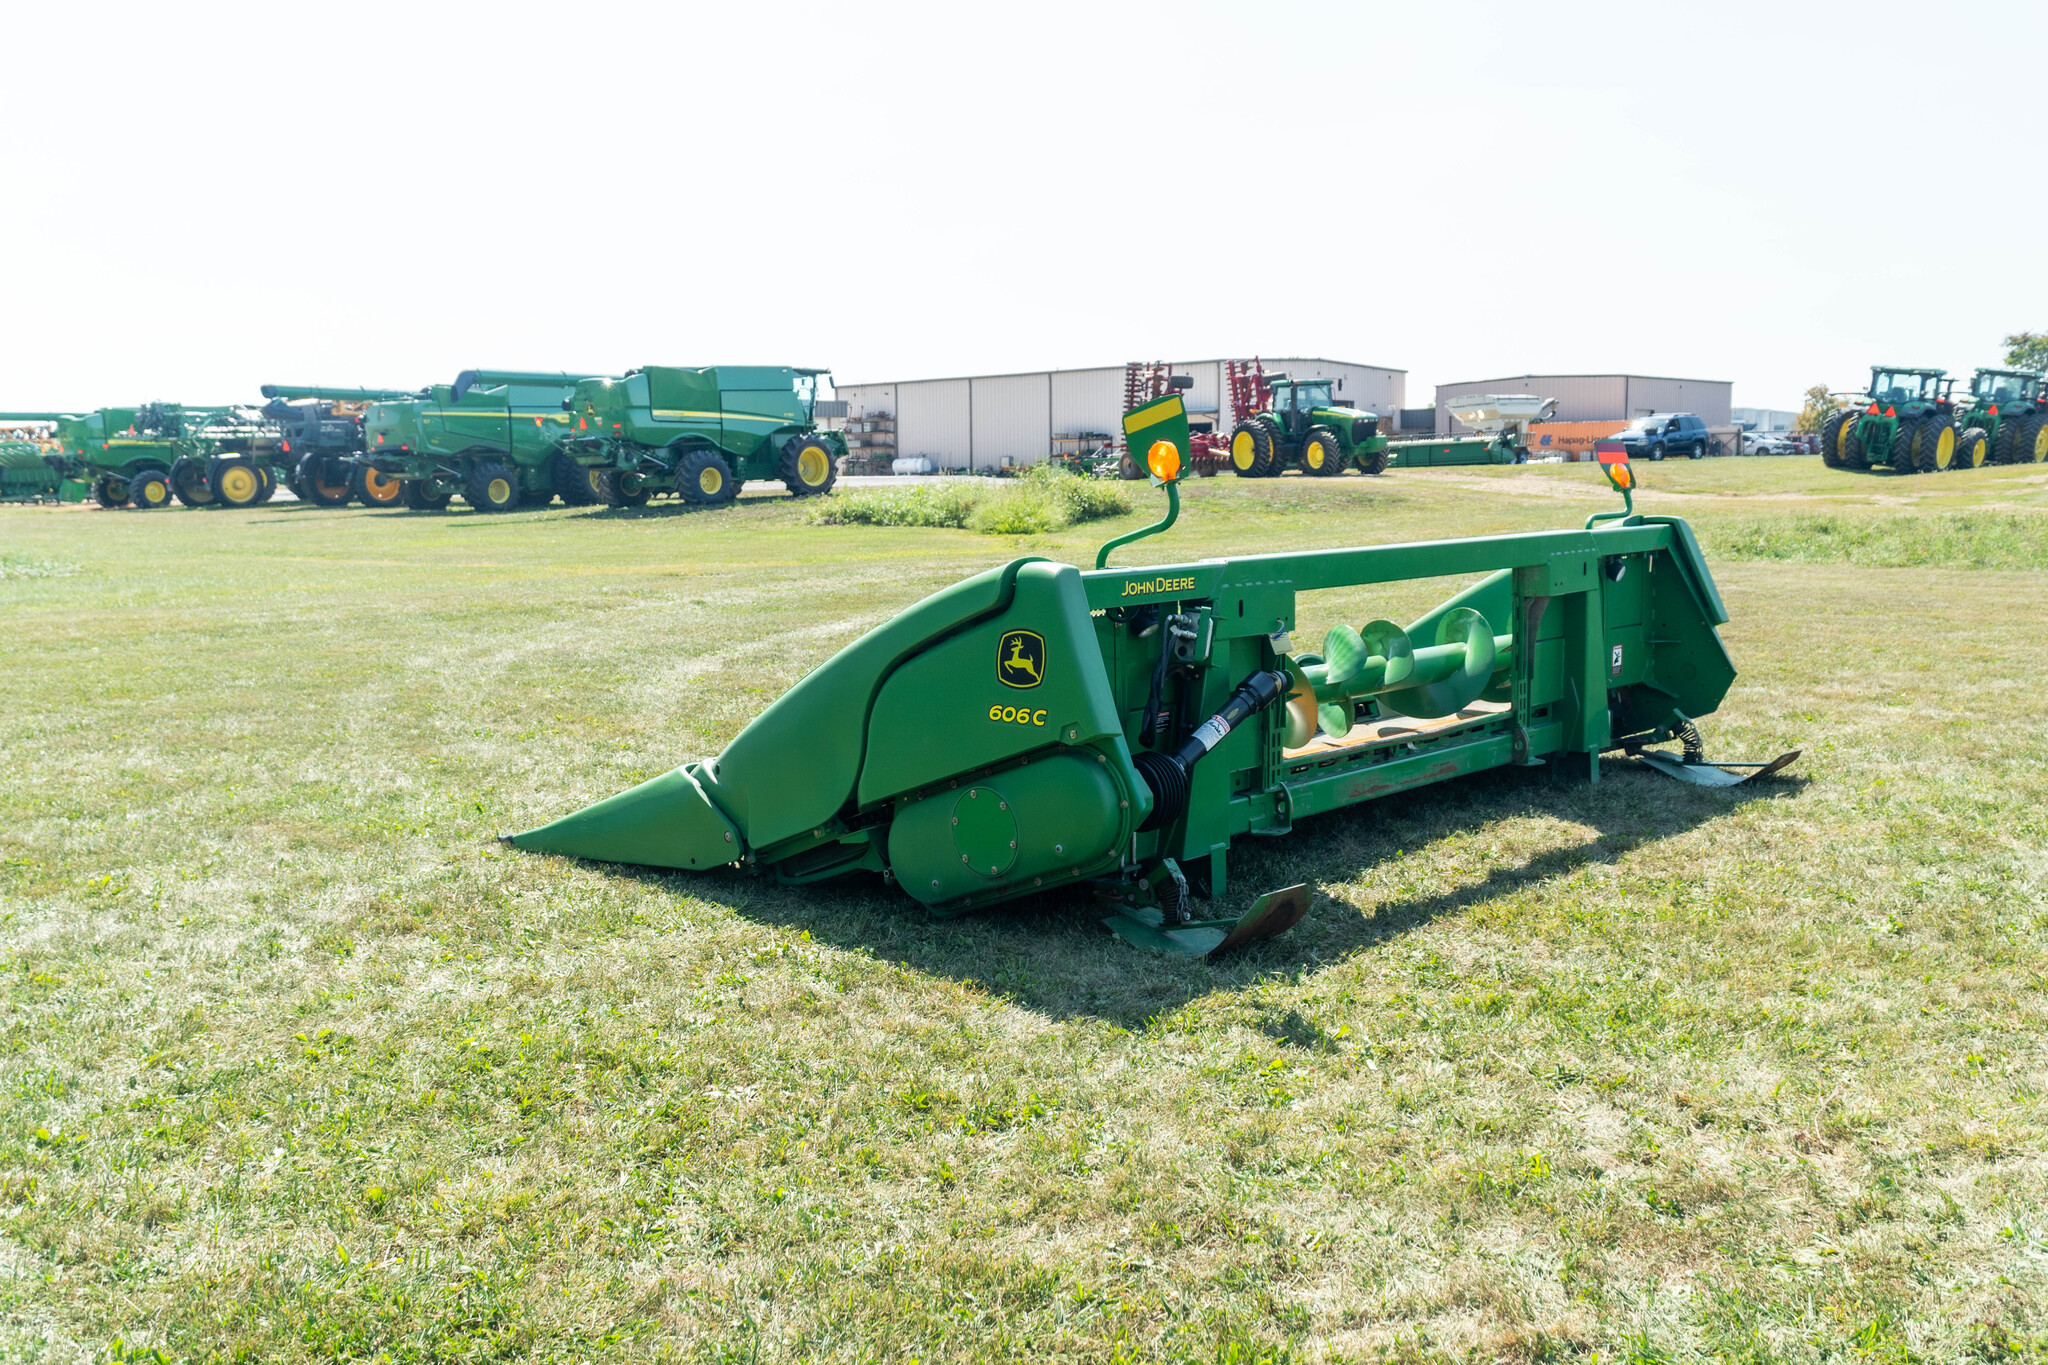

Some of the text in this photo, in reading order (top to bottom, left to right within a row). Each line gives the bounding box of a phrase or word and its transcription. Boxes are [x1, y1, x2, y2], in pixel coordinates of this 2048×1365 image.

[1121, 577, 1196, 597] JOHN DEERE
[989, 704, 1048, 727] 606C
